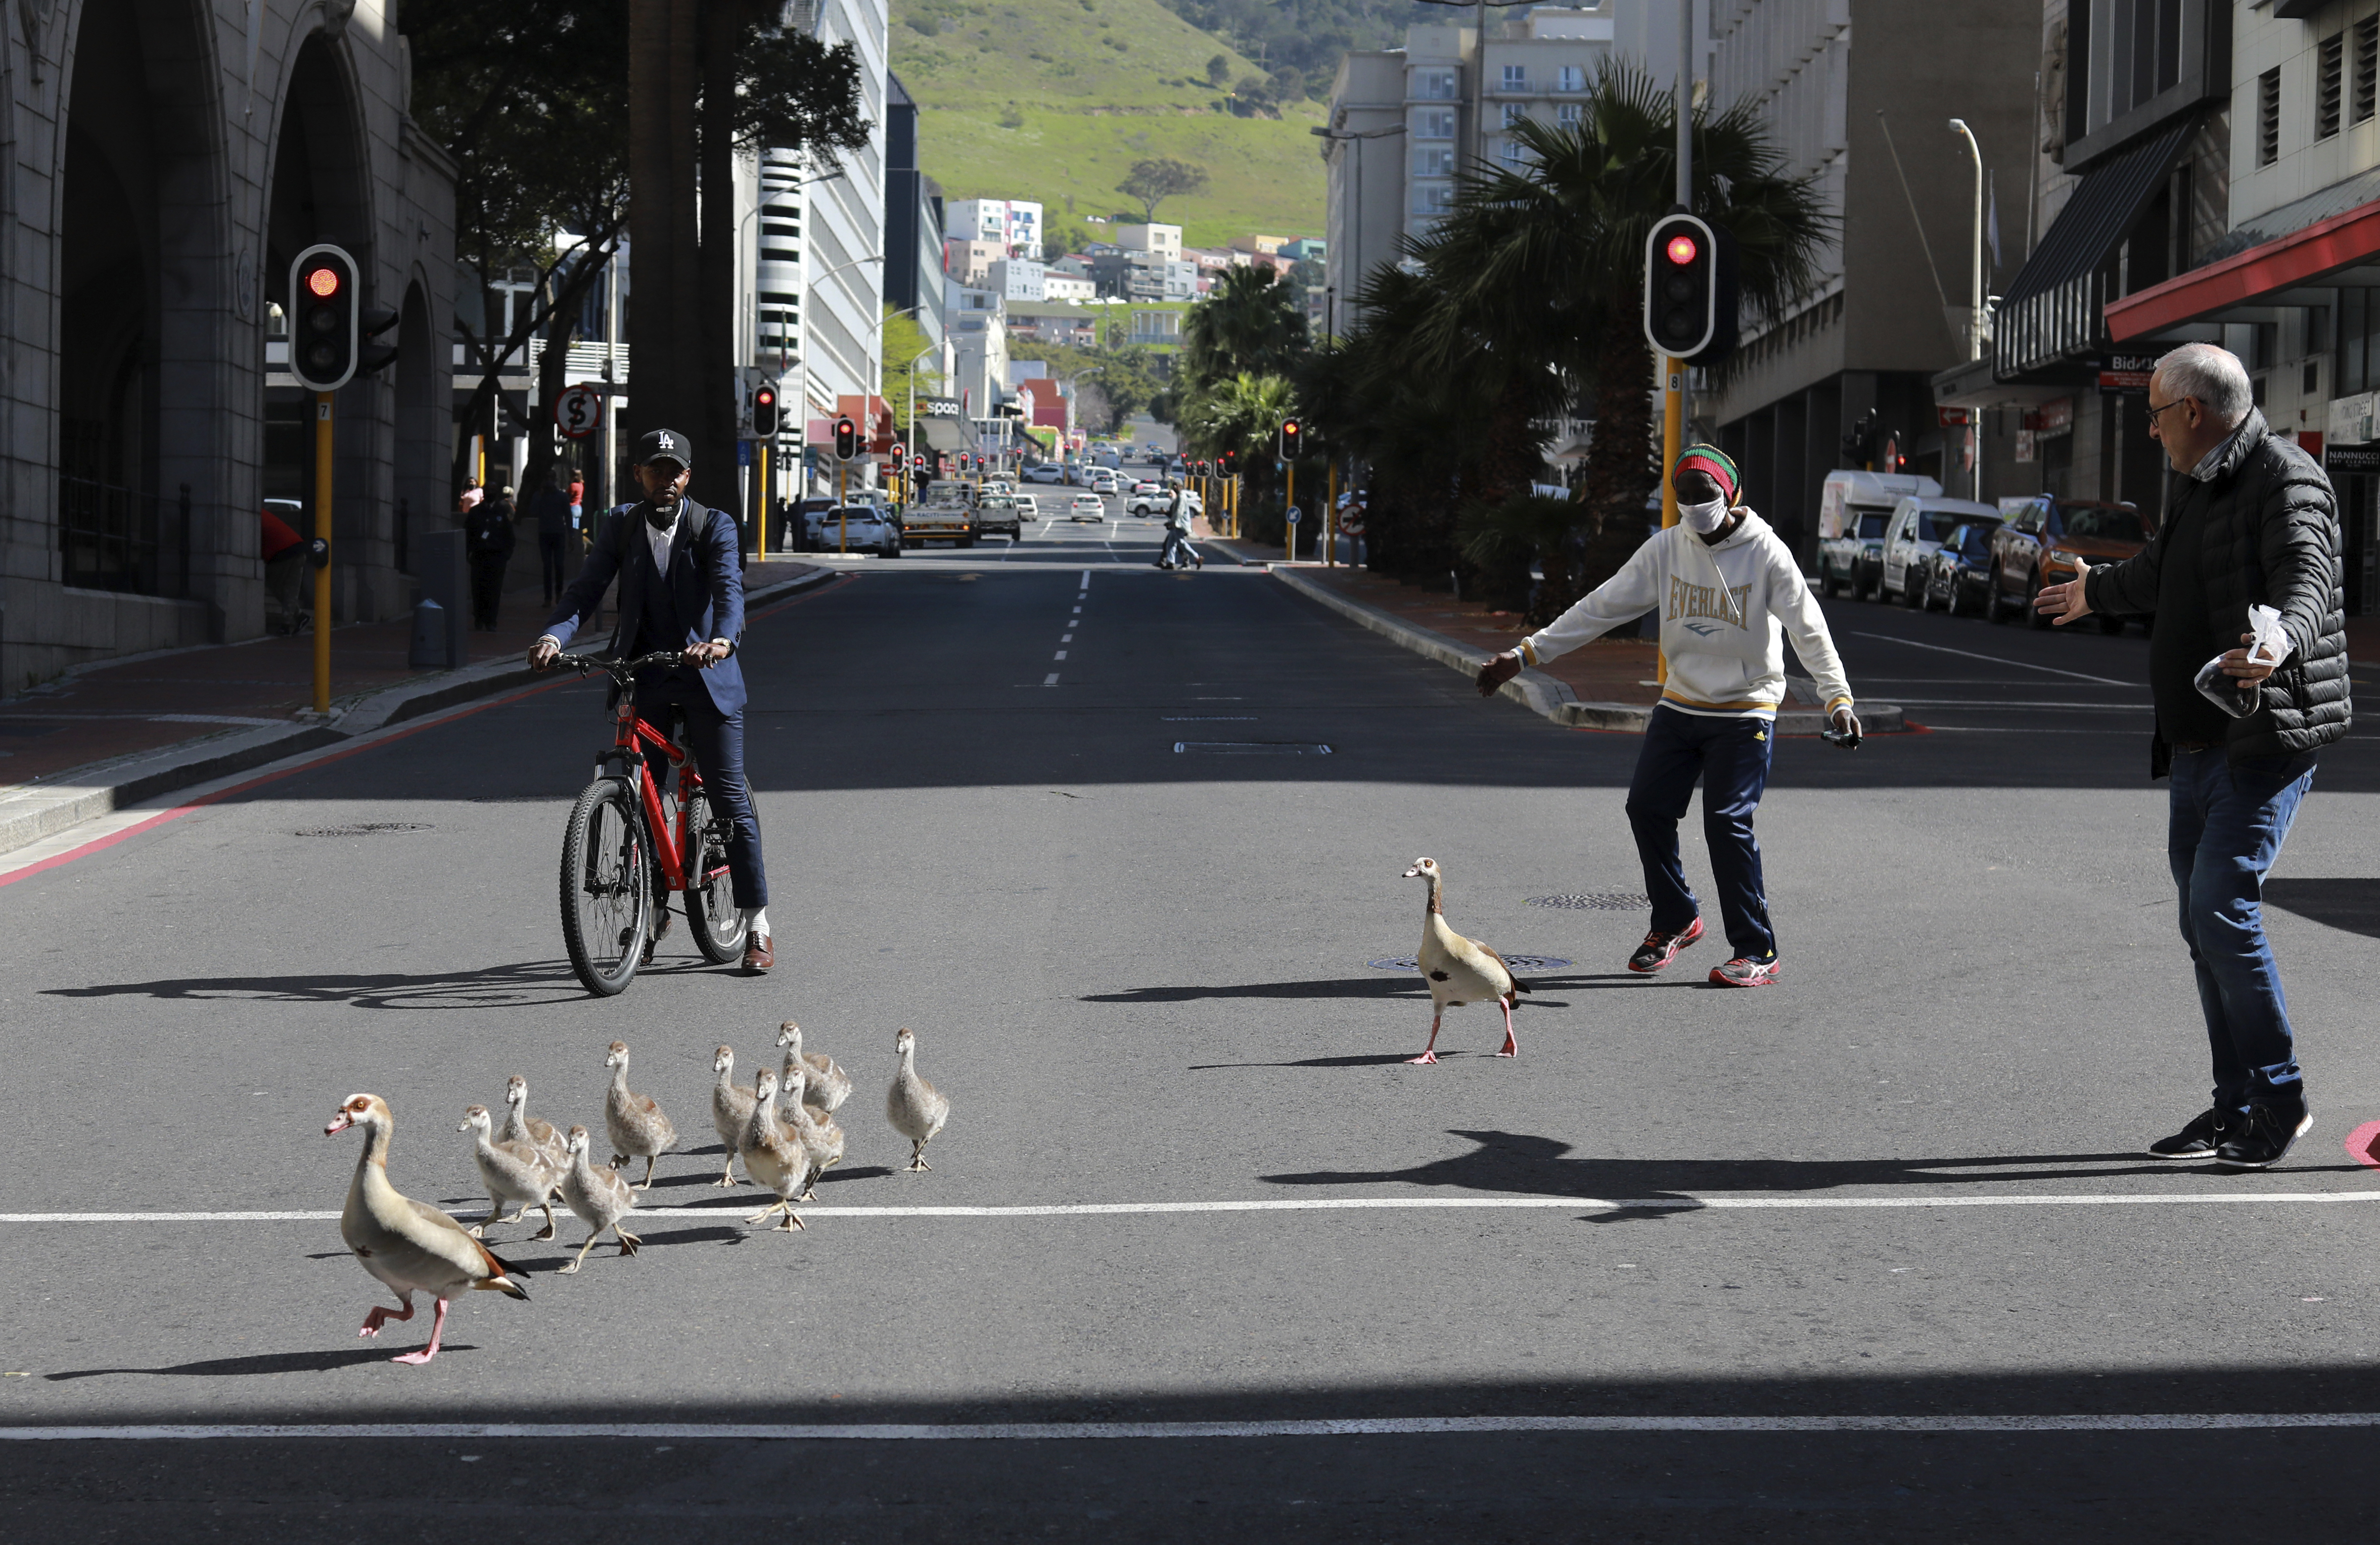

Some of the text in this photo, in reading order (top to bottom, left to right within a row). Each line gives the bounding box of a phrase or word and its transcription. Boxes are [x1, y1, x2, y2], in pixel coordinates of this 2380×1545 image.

[1672, 376, 1678, 389] 8
[320, 405, 327, 417] 7
[567, 397, 586, 425] S
[658, 431, 674, 450] LA
[2329, 451, 2380, 460] NANNUCCI
[1666, 573, 1752, 631] EVERLAST
